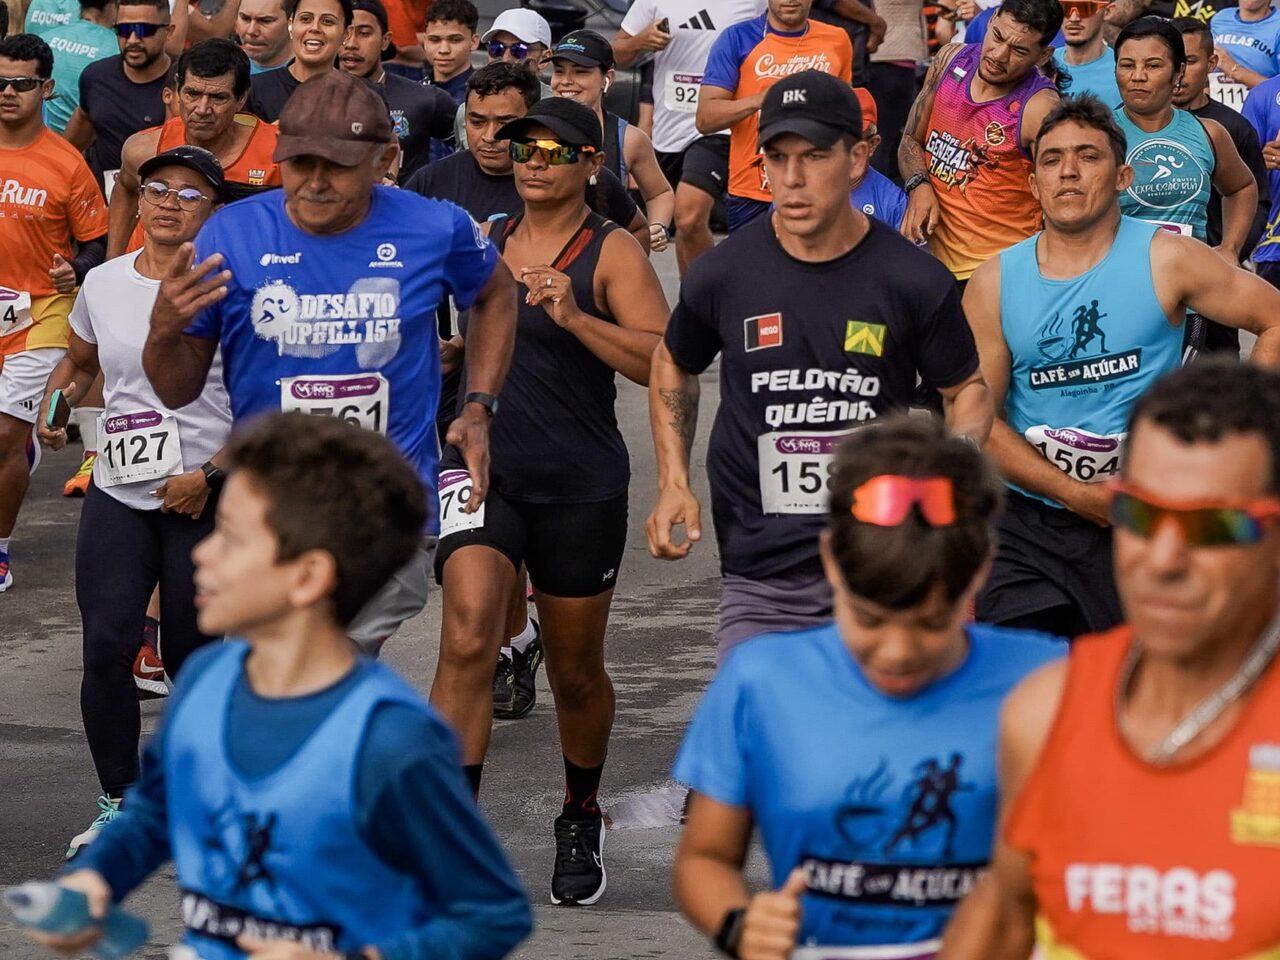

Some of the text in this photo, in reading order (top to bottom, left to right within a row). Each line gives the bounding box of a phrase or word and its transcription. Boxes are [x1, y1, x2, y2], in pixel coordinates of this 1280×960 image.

[30, 9, 73, 26] EQUIPE
[50, 36, 100, 59] EQUIPE
[787, 52, 827, 64] alma de
[782, 89, 807, 104] BK
[299, 292, 398, 320] DESAFIO
[281, 320, 364, 345] UPHILL
[760, 325, 778, 336] NEGO
[751, 368, 880, 397] PELOTÃO
[1031, 354, 1139, 386] CAFÉ SEM AÇÚCAR
[1060, 386, 1099, 398] Alagoinha
[103, 431, 169, 469] 1127
[890, 867, 990, 907] AÇÚCA
[1064, 861, 1237, 924] FERAS
